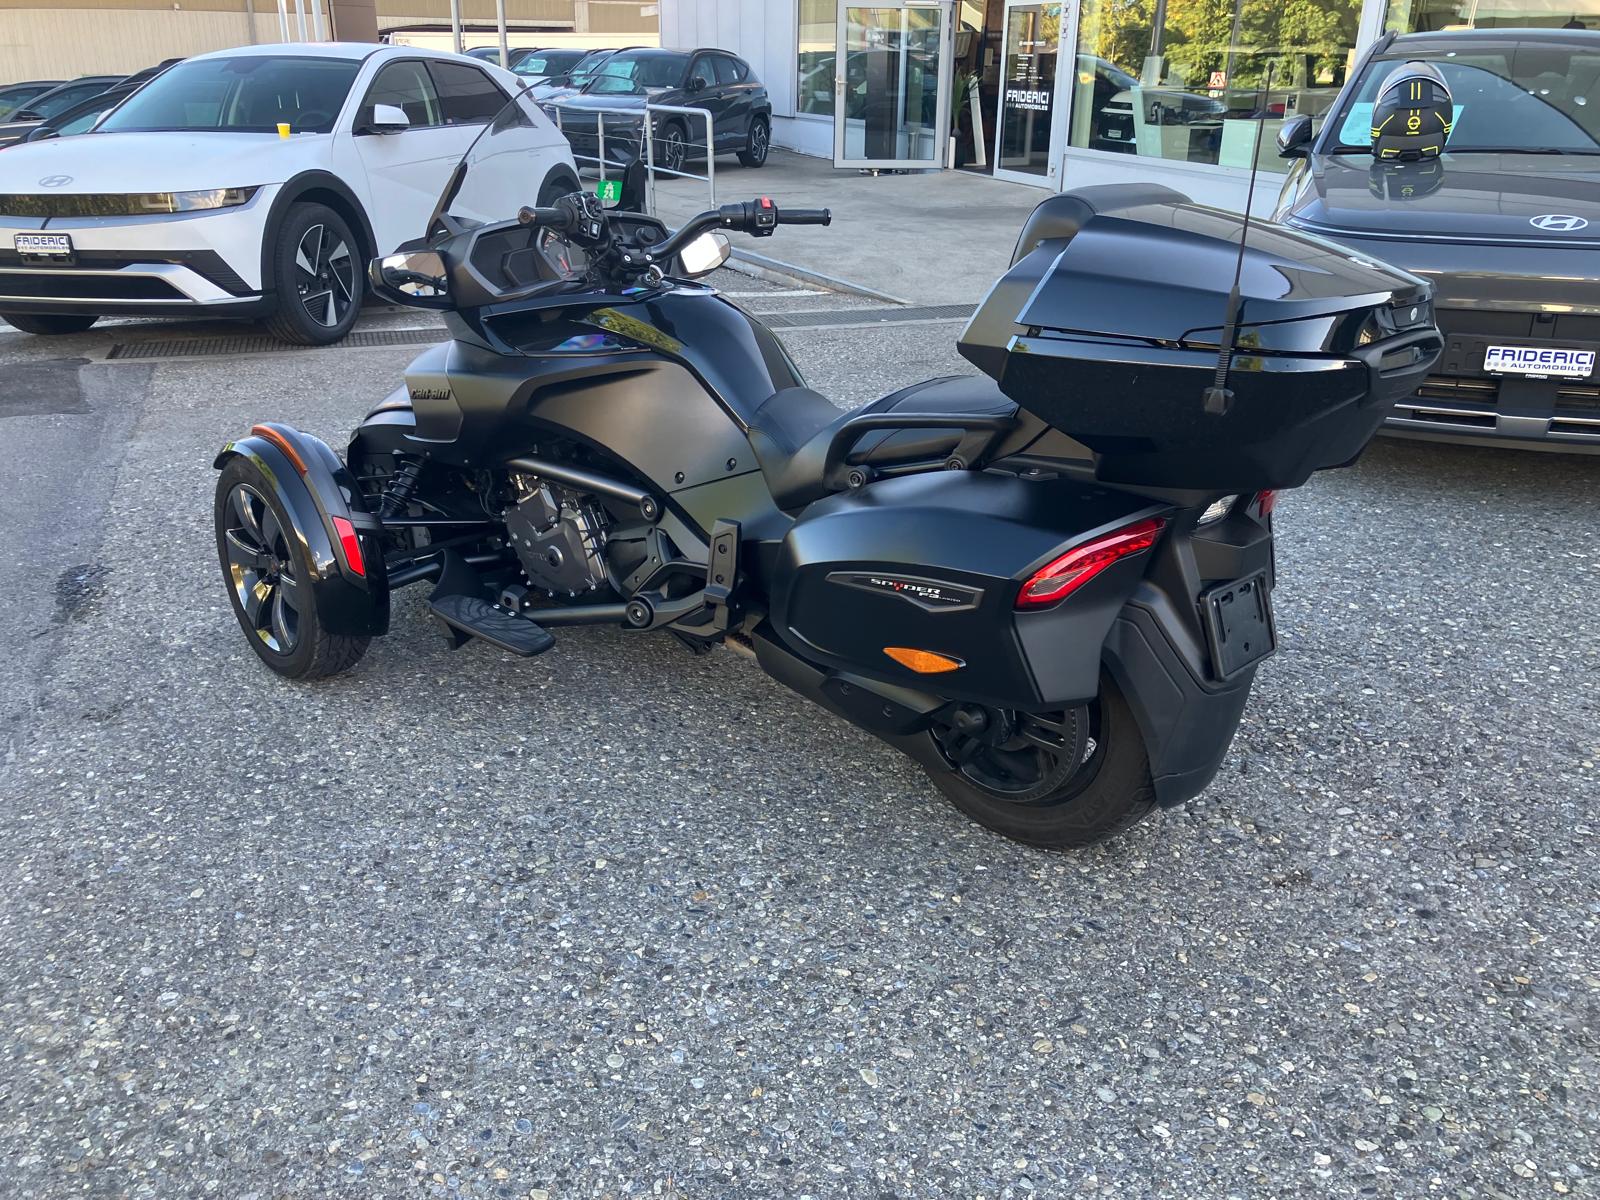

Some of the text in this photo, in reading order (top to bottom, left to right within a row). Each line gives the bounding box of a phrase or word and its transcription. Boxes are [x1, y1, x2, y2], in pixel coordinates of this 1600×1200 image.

[1006, 90, 1049, 104] FRIDERICI
[1015, 103, 1048, 111] AUTOMOBILES
[16, 236, 69, 245] FRIDERICI
[1487, 349, 1594, 365] FRIDERICI
[1510, 362, 1592, 372] AUTOMOBILES
[870, 578, 941, 595] SPYDER
